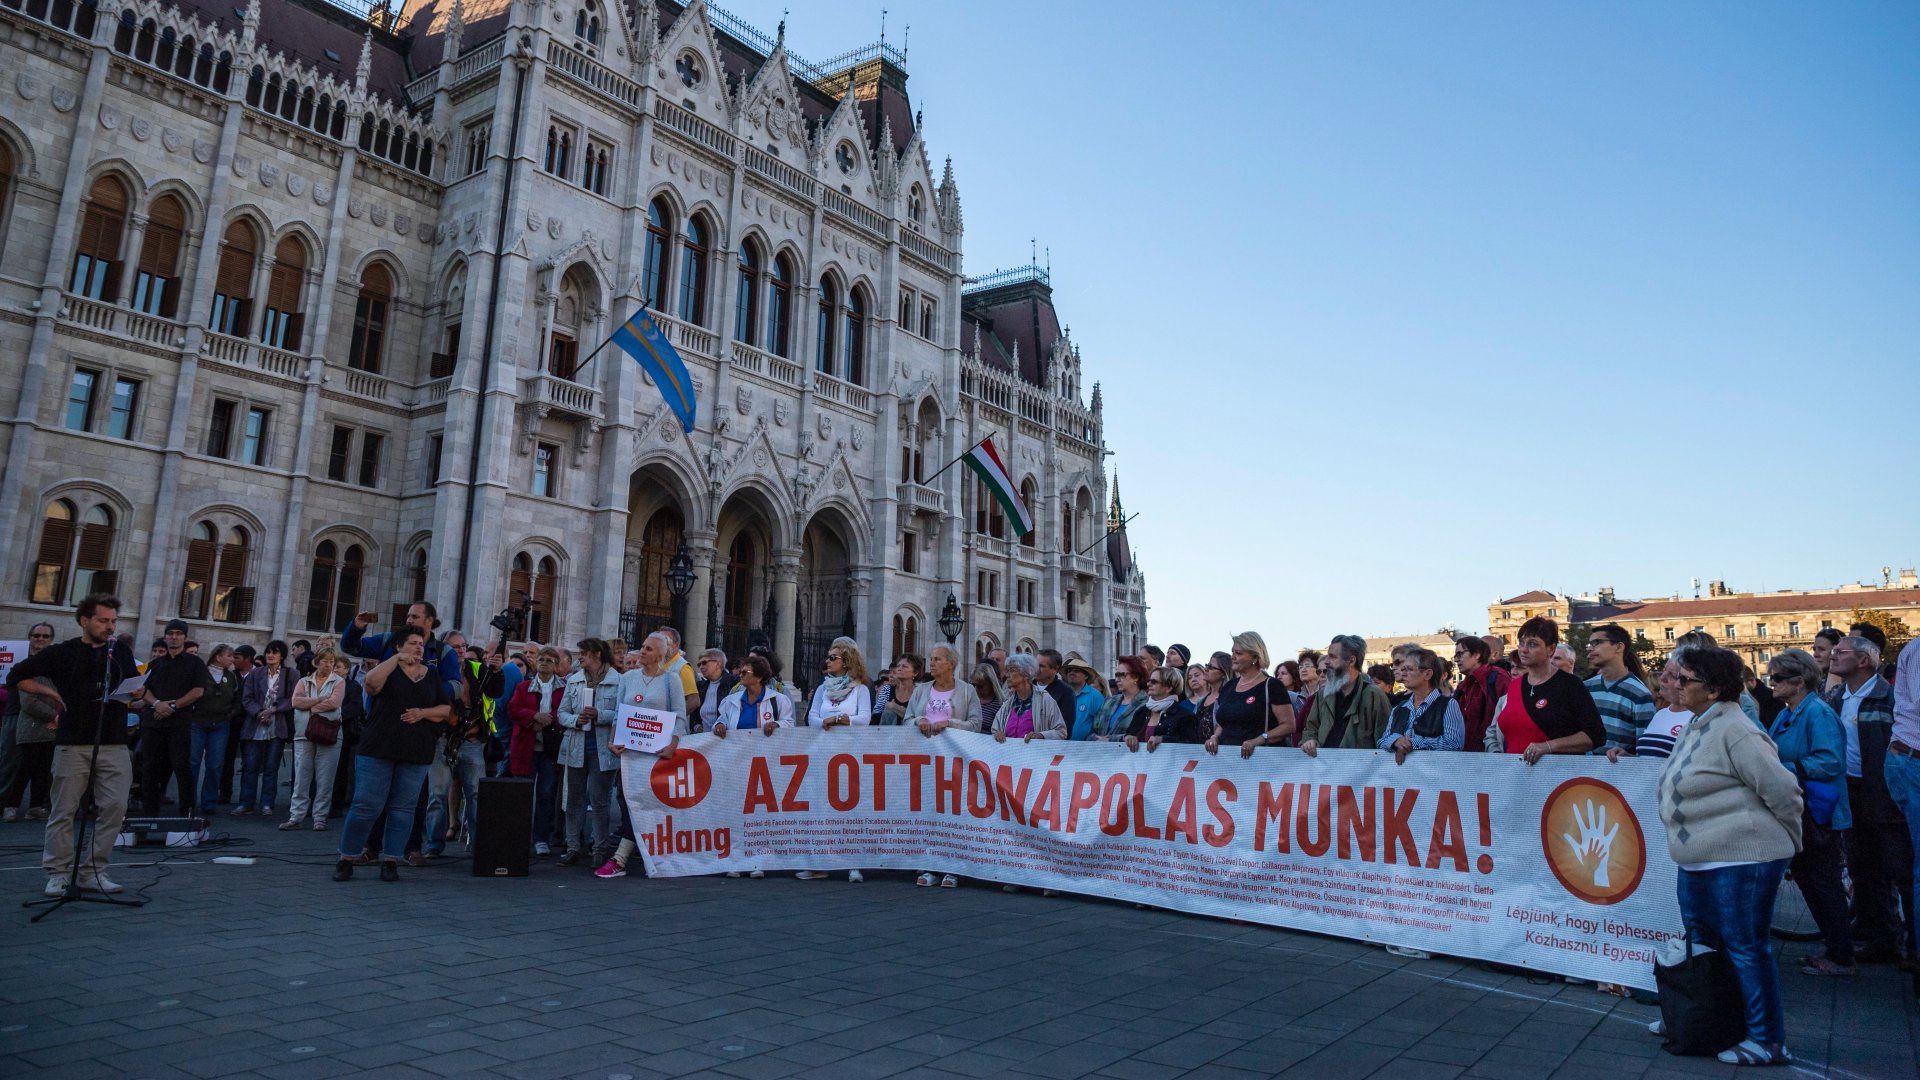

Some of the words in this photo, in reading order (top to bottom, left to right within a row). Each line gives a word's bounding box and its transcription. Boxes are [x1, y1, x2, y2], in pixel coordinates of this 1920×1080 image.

[633, 712, 658, 721] Azonnali
[743, 755, 809, 815] AZ
[827, 754, 1237, 847] OTTHONÁPOLÁS
[1254, 783, 1492, 873] MUNKA!
[1506, 906, 1561, 928] Lépjünk,
[1565, 913, 1599, 934] hogy
[1525, 930, 1598, 955] Közhasznú
